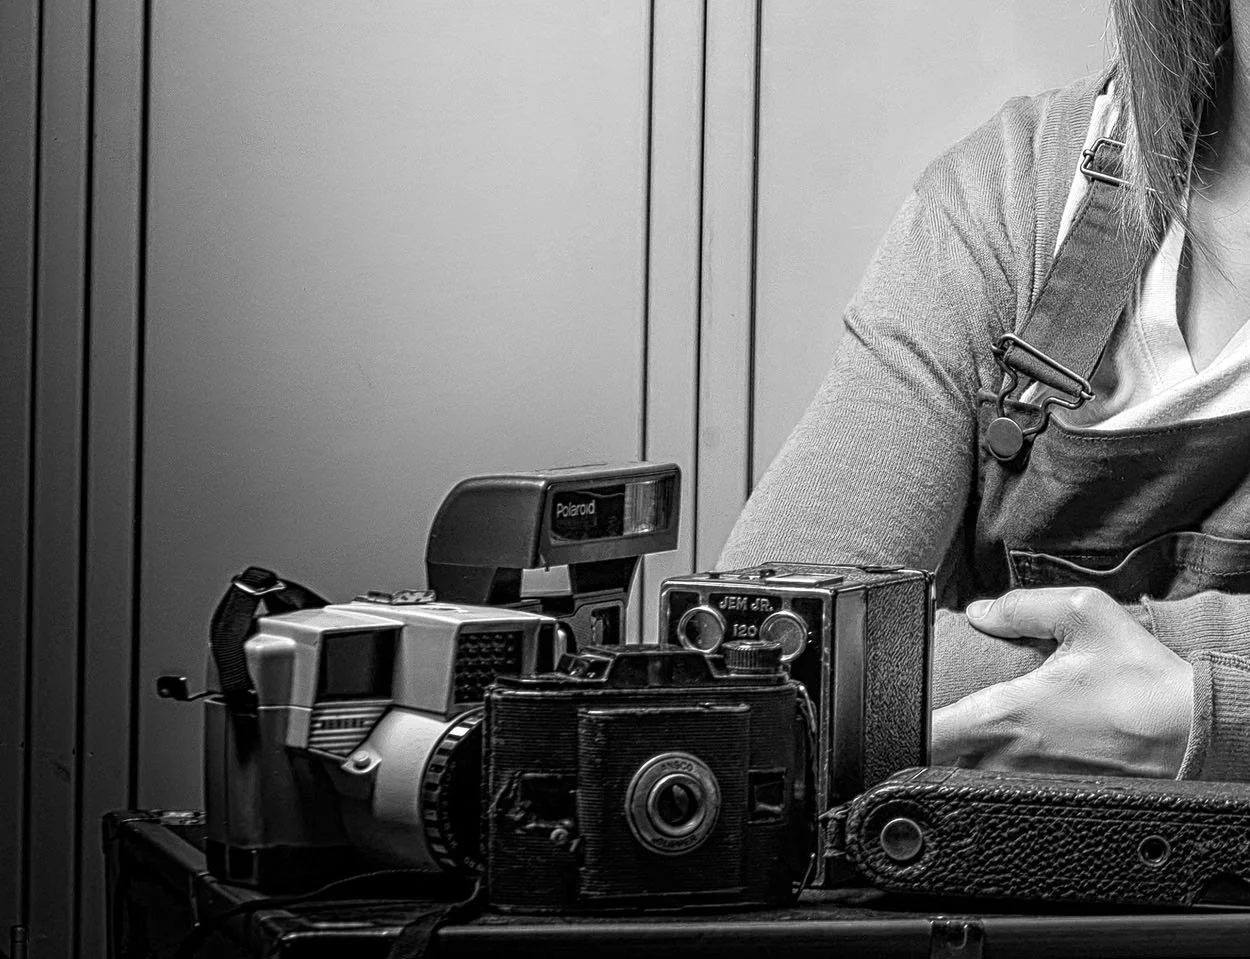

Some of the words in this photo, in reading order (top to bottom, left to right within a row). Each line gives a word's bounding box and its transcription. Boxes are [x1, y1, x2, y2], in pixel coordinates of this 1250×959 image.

[556, 499, 596, 518] Polaroid
[720, 596, 748, 610] JEM
[751, 598, 774, 612] JR.
[733, 624, 758, 637] 120
